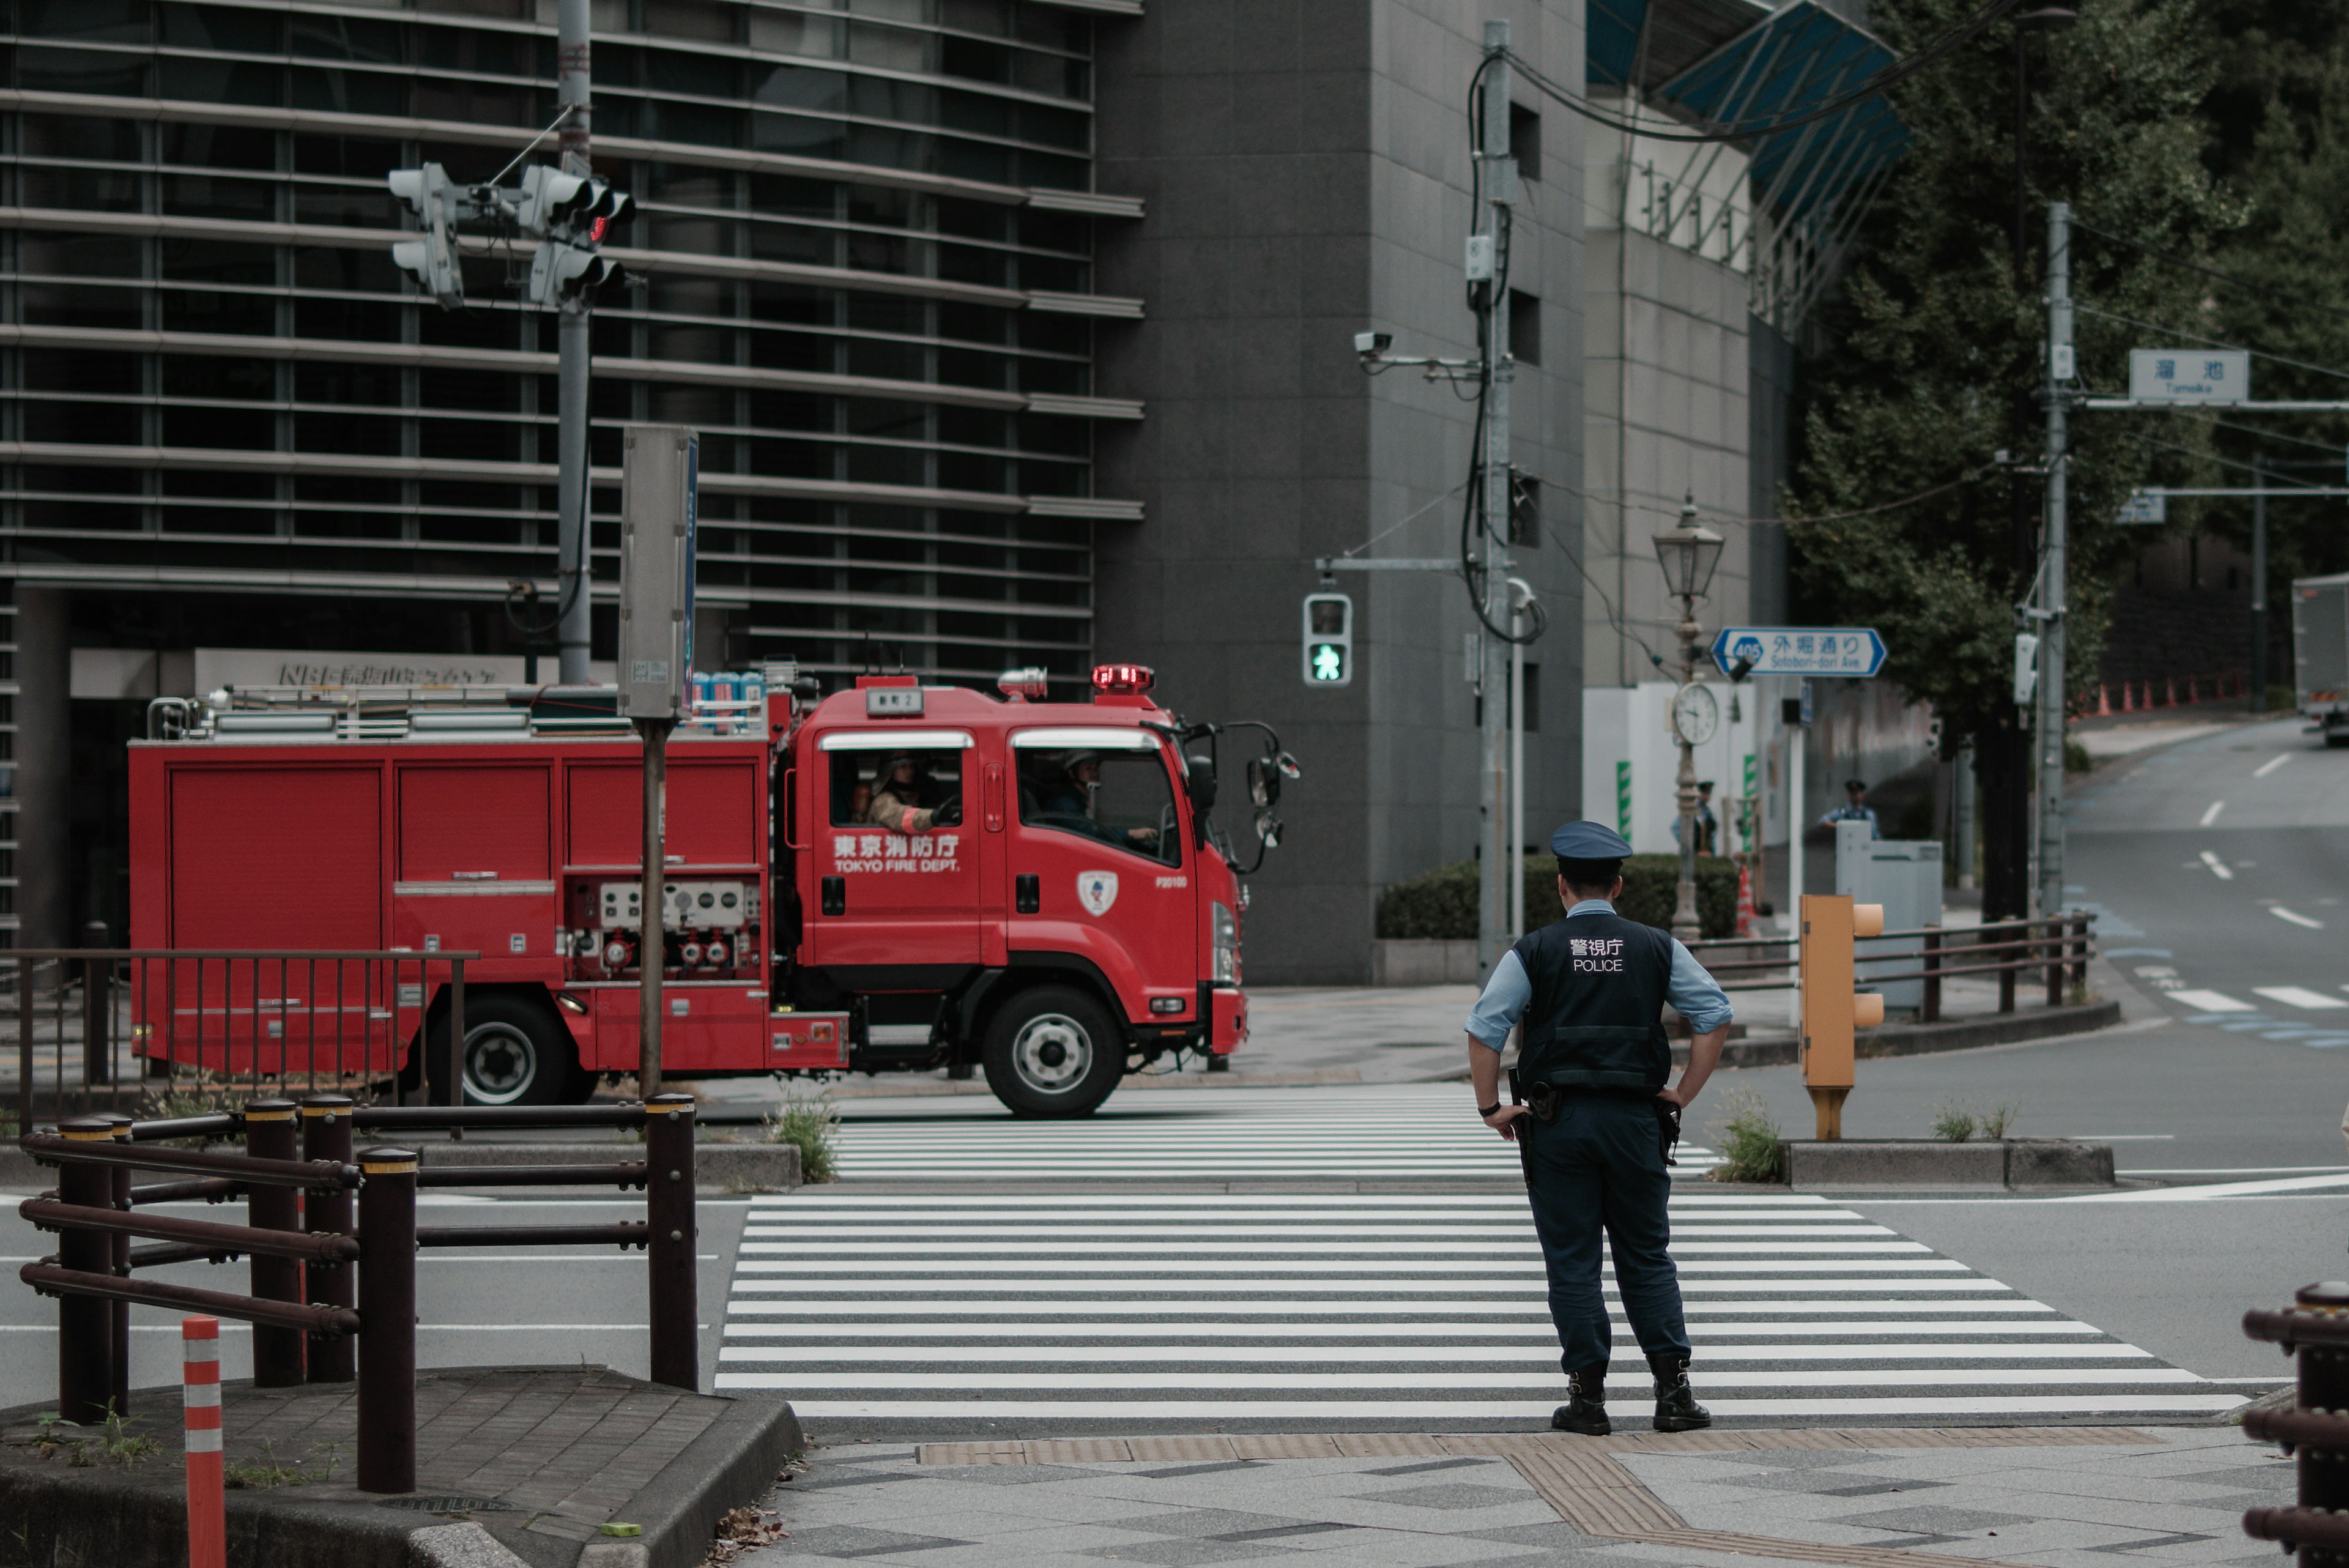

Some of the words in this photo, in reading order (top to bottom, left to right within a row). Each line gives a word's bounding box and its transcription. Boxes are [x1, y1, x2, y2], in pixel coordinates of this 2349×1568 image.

[1735, 644, 1761, 658] 405
[1772, 635, 1859, 655] 外堀通り
[834, 834, 960, 858] 東京消防庁
[834, 859, 883, 873] TOKYO
[885, 859, 918, 872] FIRE
[920, 859, 961, 872] DEPT.
[1570, 938, 1624, 956] 警視庁
[1573, 959, 1624, 972] POLICE
